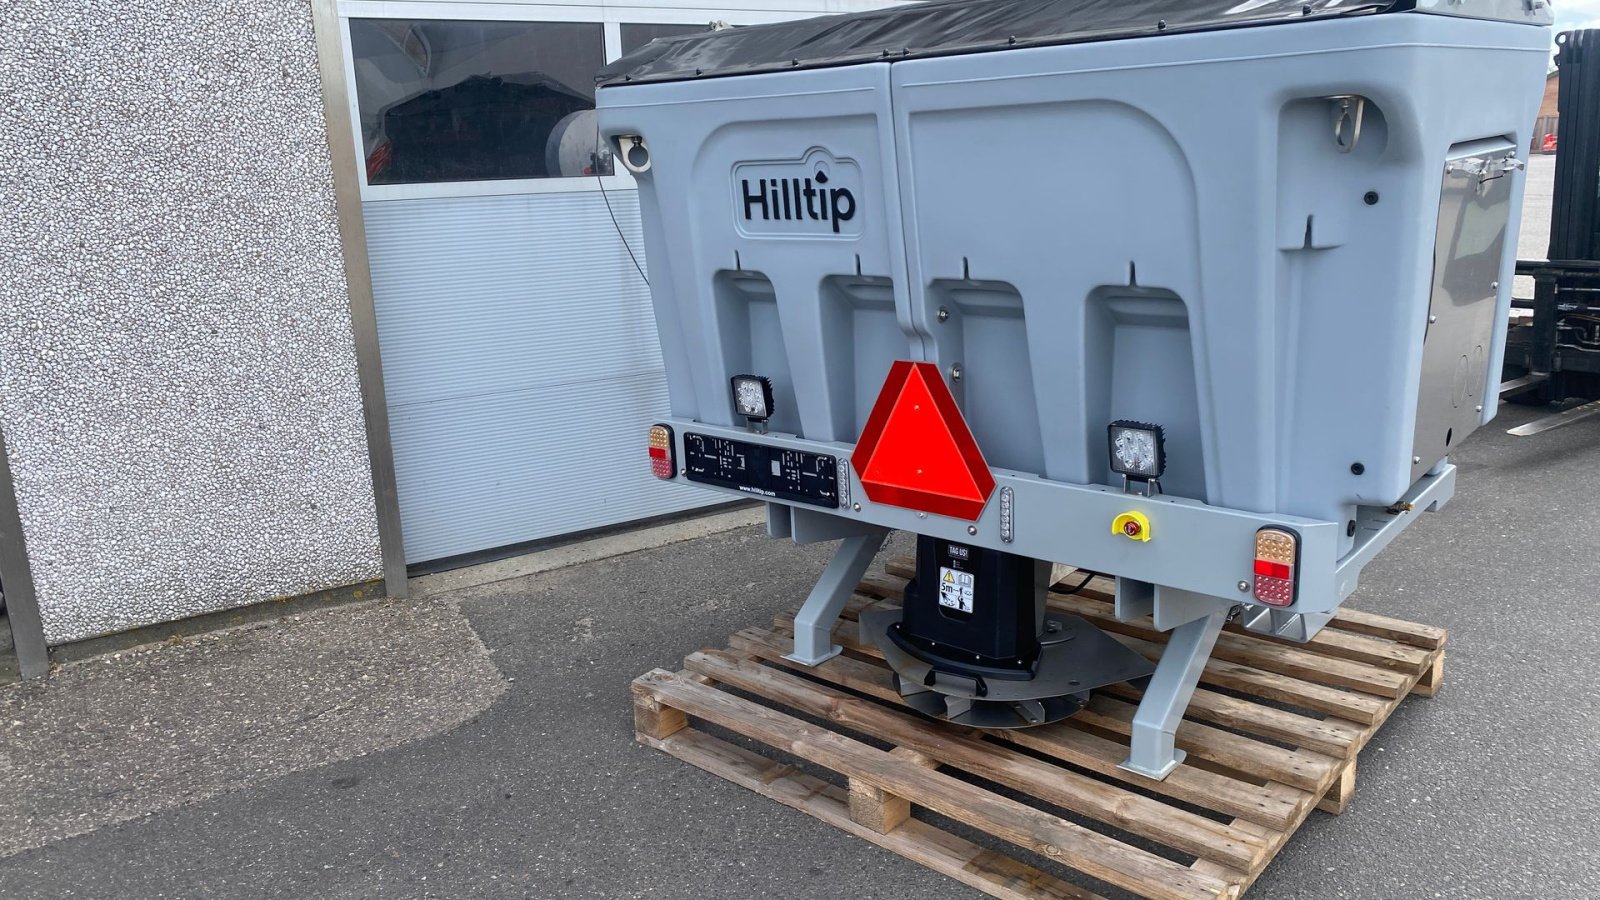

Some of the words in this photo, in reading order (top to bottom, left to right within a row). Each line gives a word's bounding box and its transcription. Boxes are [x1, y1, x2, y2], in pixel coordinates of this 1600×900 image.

[741, 170, 856, 233] Hilltip
[739, 485, 776, 497] www.hilltip.com
[941, 582, 953, 593] 5m
